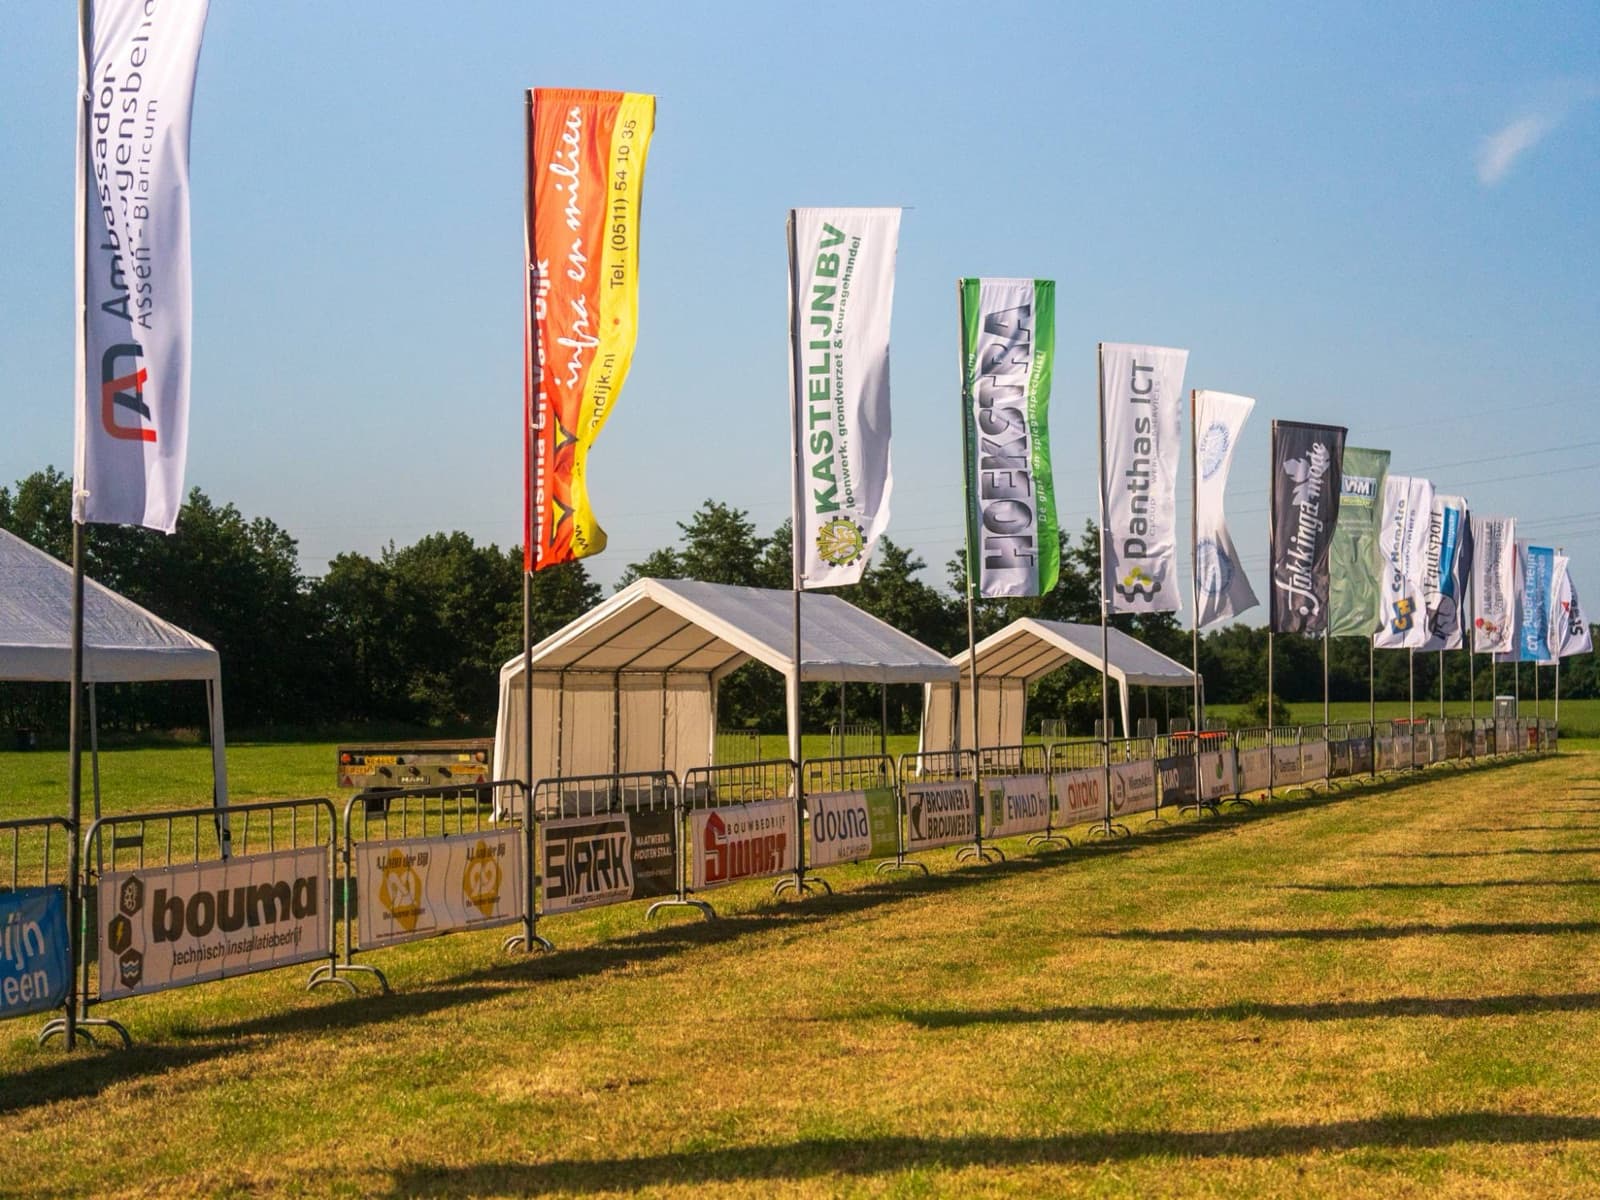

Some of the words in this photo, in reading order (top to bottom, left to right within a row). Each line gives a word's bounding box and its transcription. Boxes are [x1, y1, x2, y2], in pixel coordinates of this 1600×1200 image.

[621, 119, 637, 140] 35
[134, 100, 158, 220] Blaricum
[550, 105, 583, 232] milieu
[617, 145, 630, 163] 10
[614, 170, 628, 191] 54
[611, 198, 630, 251] (0511)
[567, 238, 588, 284] en
[610, 258, 625, 289] Tel.
[815, 222, 847, 279] BV
[132, 247, 153, 330] Assen
[834, 236, 862, 334] fouragehandel
[834, 339, 844, 349] &
[808, 284, 841, 514] KASTELIJN
[834, 354, 847, 437] grondverzet
[1130, 359, 1155, 404] ICT
[978, 304, 1034, 569] HOEKSTRA
[838, 440, 856, 509] loonwerk,
[1124, 417, 1152, 559] Danthas
[1305, 442, 1326, 498] mode
[1038, 507, 1048, 522] De
[1424, 510, 1444, 589] Equisport
[1391, 567, 1402, 593] Cor
[1523, 589, 1534, 628] Albert
[813, 798, 869, 843] douna
[925, 790, 964, 814] BROUWER
[1007, 794, 1037, 820] EWALD
[726, 815, 787, 836] BOUWBEDRIJF
[927, 815, 966, 840] BROUWER
[545, 820, 630, 899] STARK
[152, 875, 318, 943] bouma
[0, 911, 45, 971] ijn
[172, 937, 226, 967] technisch
[227, 926, 304, 957] installatiebedrijf
[0, 970, 49, 1005] een
